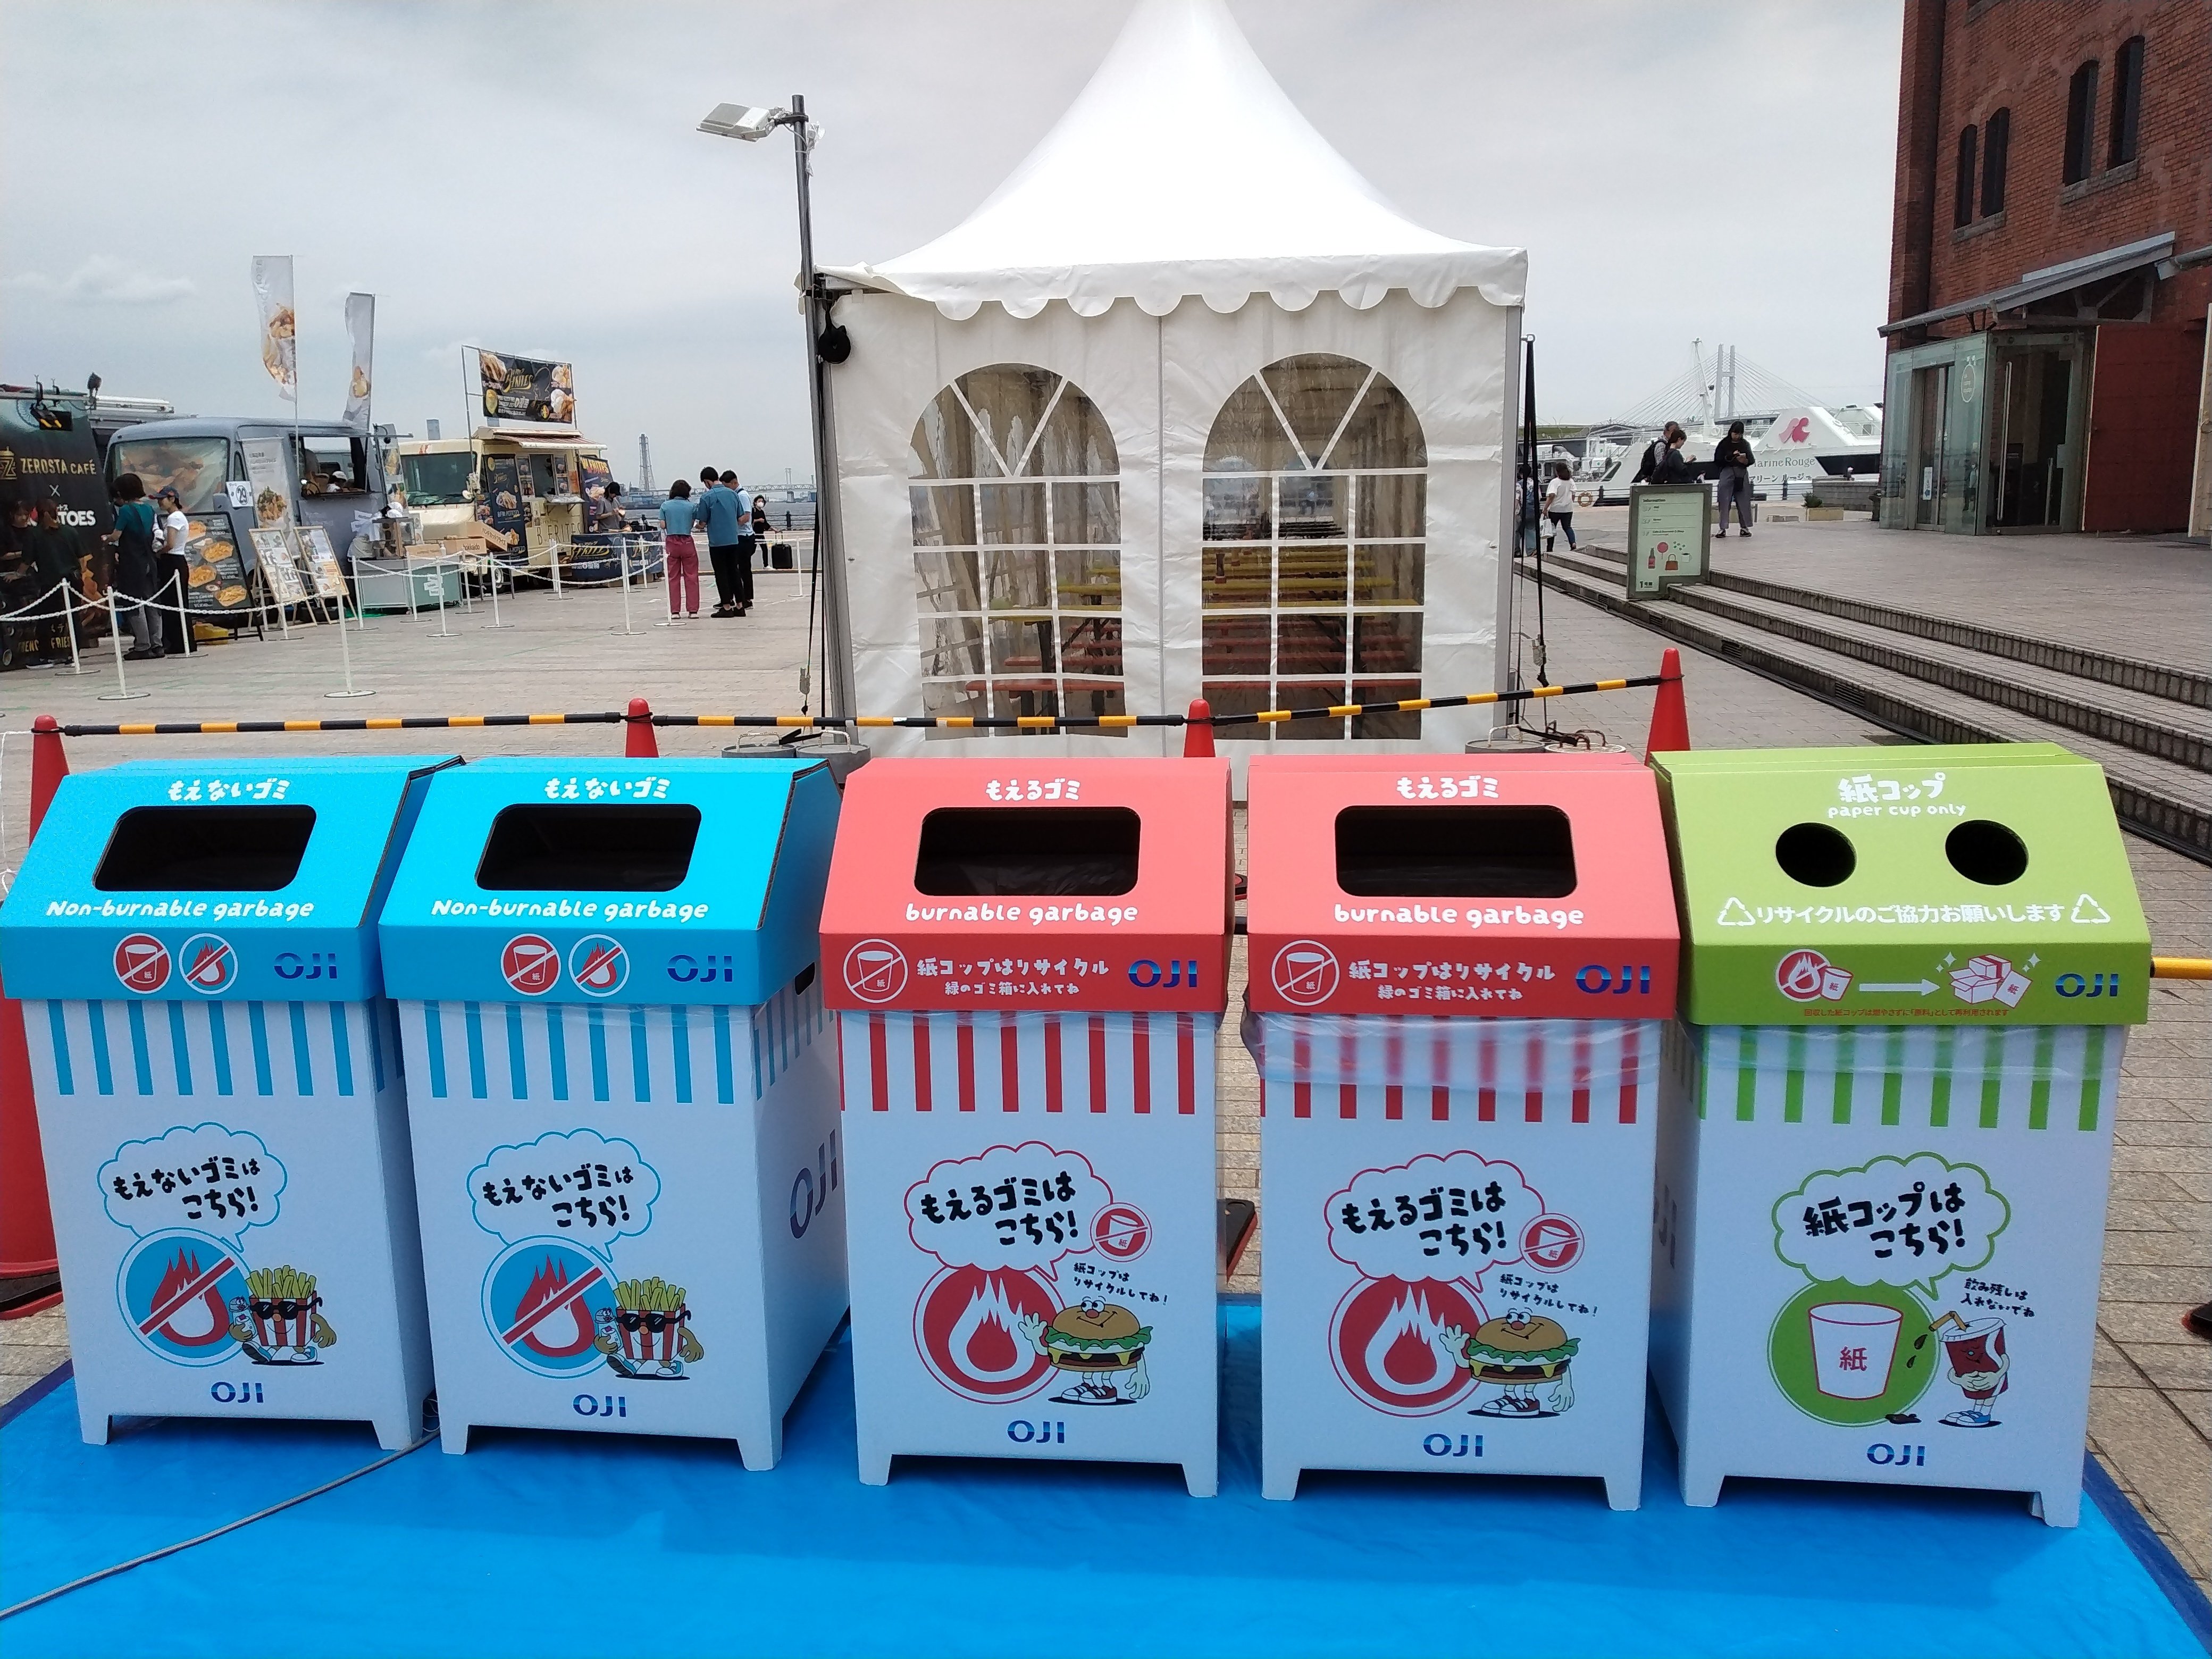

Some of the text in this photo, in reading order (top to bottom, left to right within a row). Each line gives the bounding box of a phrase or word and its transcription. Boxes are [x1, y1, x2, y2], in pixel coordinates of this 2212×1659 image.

[20, 457, 97, 475] ZEROSTA CAFÉ
[1785, 457, 1815, 467] Rouge
[237, 488, 247, 502] 29
[168, 778, 290, 802] もえないゴミ
[544, 776, 671, 800] もえないゴミ
[986, 778, 1080, 801] もえるゴミ
[1396, 775, 1500, 799] もえるゴミ
[1838, 772, 1946, 803] 紙コップ
[1828, 803, 1966, 819] paper cup only
[46, 901, 315, 922] Non-burnable garbage
[431, 899, 708, 923] Non-burnable garbage
[906, 903, 1138, 926] burnable garbage
[1334, 904, 1584, 929] burnable garbage
[1756, 904, 2065, 924] リサイクルのご協力お願いします
[274, 953, 337, 979] OJI
[667, 954, 733, 982] OJI
[917, 957, 1109, 978] 紙コップはリサイクル
[1128, 959, 1196, 988] OJI
[1348, 960, 1556, 982] 紙コップはリサイクル
[945, 981, 1079, 995] 緑のゴミ箱に入れてね
[1576, 965, 1650, 994] OJI
[2056, 974, 2118, 998] OJI
[1377, 985, 1522, 1001] 緑のゴミ箱に入れてね
[113, 1156, 261, 1200] もえないゴミは
[482, 1163, 634, 1206] もえないゴミは
[790, 1129, 839, 1239] OJI
[182, 1186, 258, 1219] こちら!
[920, 1170, 1076, 1224] もえるゴミは
[1342, 1180, 1505, 1234] もえるゴミは
[1802, 1181, 1966, 1237] 紙コップは
[551, 1195, 630, 1228] こちら!
[995, 1210, 1078, 1245] こちら!
[1419, 1221, 1506, 1256] こちら!
[1870, 1218, 1965, 1258] こちら!
[1074, 1262, 1129, 1282] 紙コップは
[1500, 1273, 1559, 1294] 紙コップは
[1964, 1278, 2027, 1301] 飲み残しは
[1962, 1295, 2035, 1318] 入れないでね
[1839, 1346, 1867, 1371] 紙
[211, 1382, 264, 1403] OJI
[573, 1394, 626, 1418] OJI
[1007, 1420, 1065, 1444] OJI
[1423, 1433, 1484, 1457] OJI
[1867, 1443, 1925, 1467] OJI
